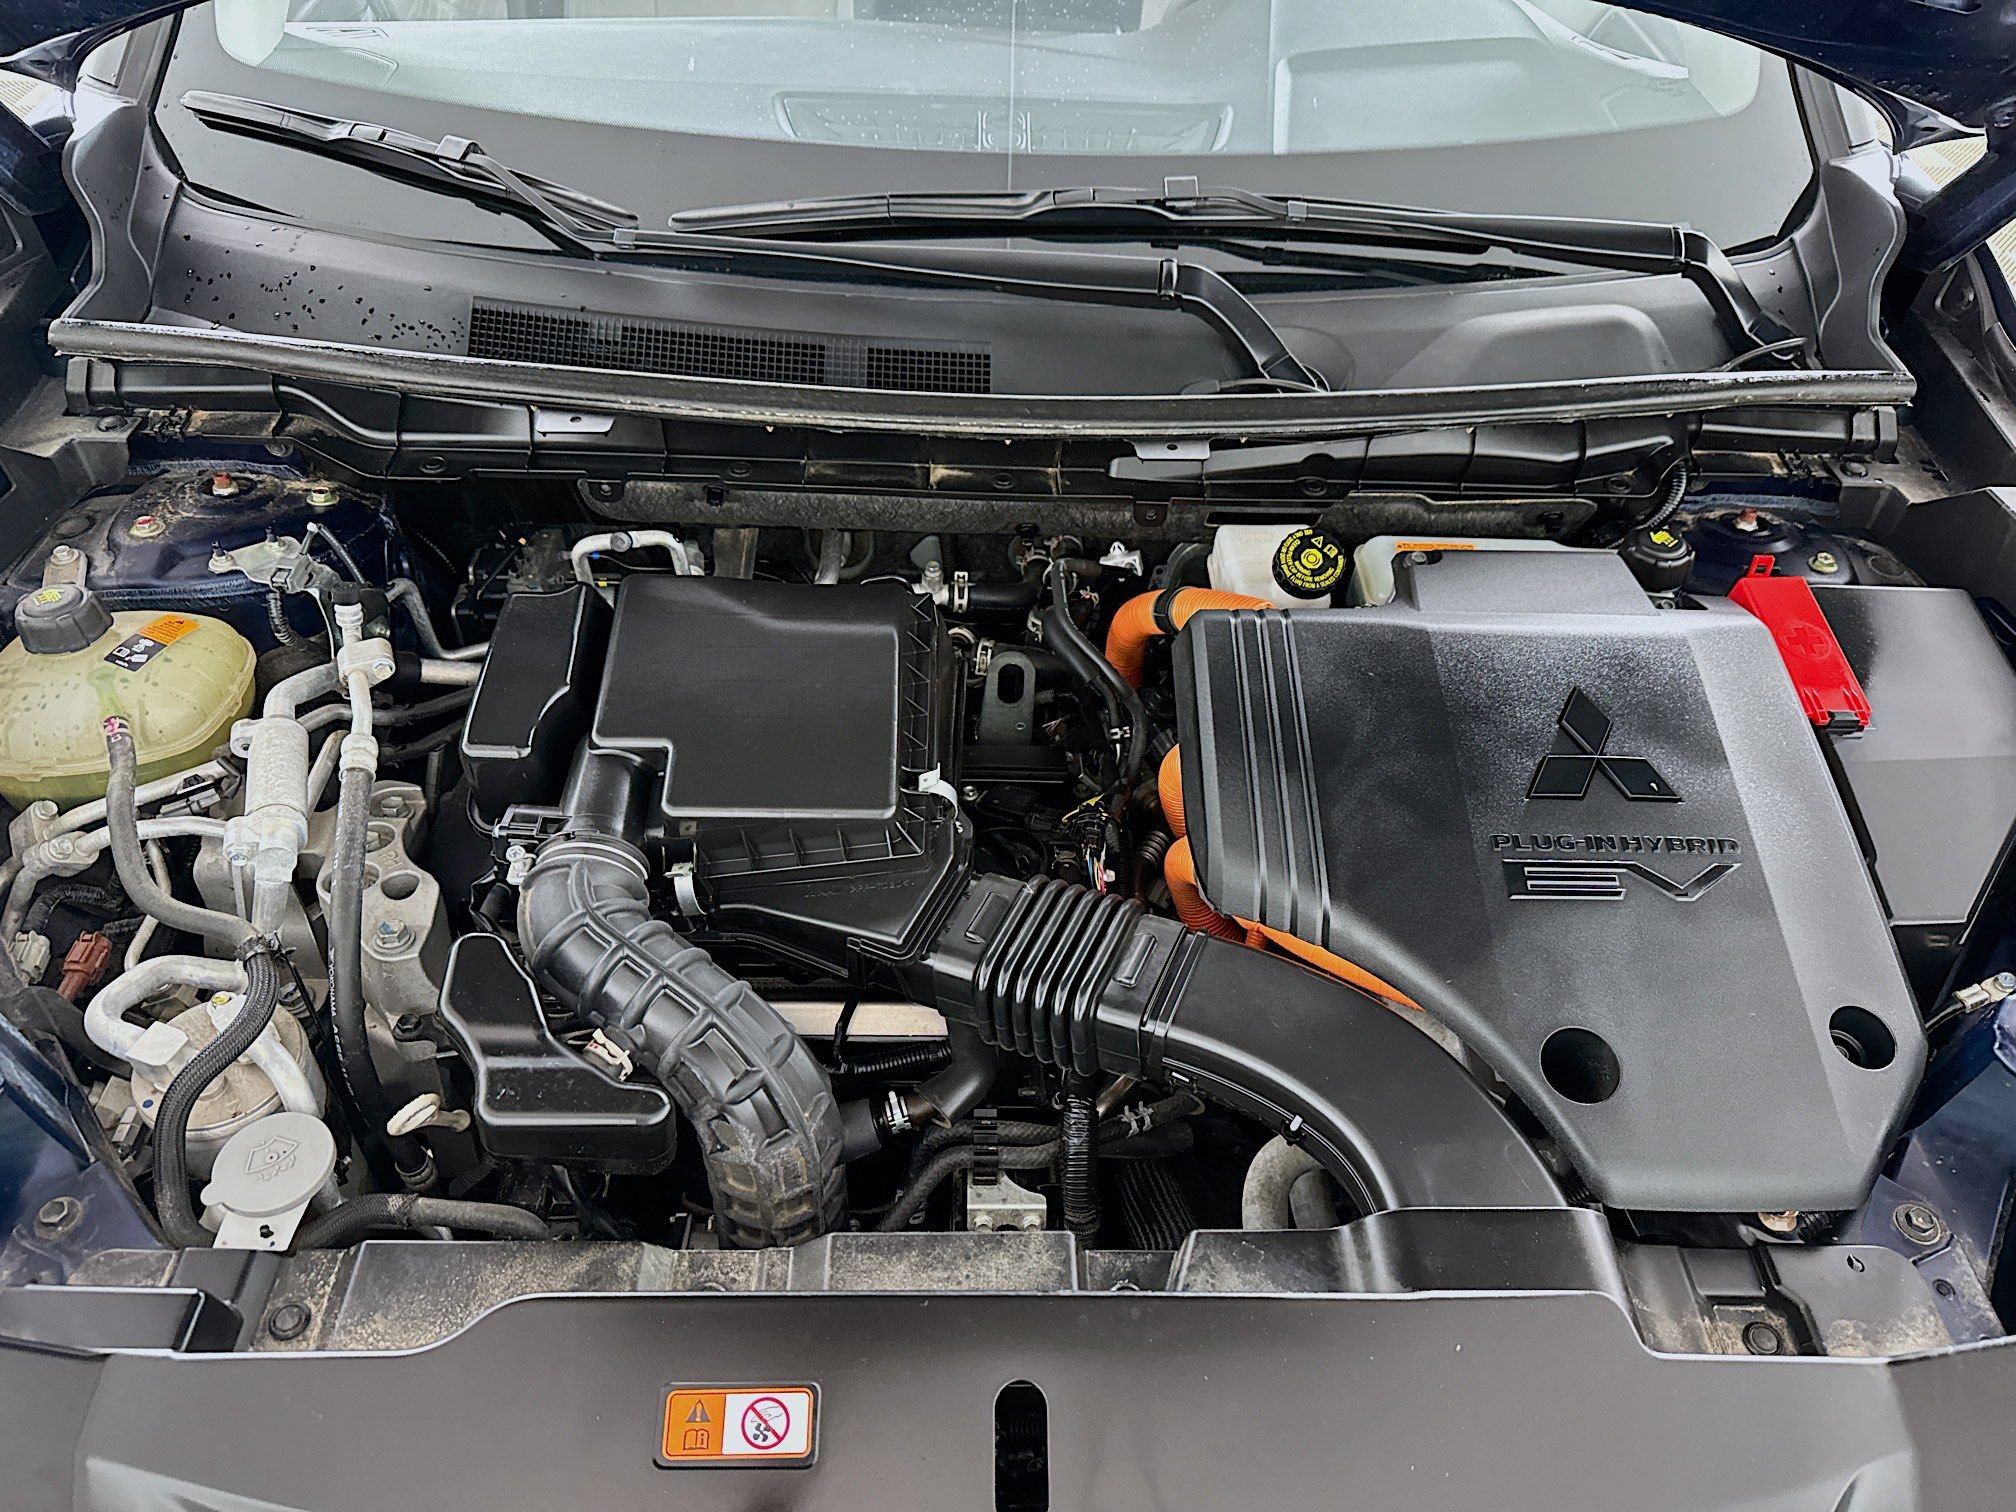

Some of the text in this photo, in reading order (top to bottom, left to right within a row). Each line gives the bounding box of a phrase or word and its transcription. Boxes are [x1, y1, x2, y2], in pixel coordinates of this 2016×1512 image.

[1289, 565, 1298, 573] CAP
[1296, 573, 1313, 582] BEFORE
[1314, 566, 1334, 582] REMOVING
[1290, 575, 1303, 586] FLUID
[1490, 834, 1741, 855] PLUG-IN HYBRID
[1502, 859, 1742, 901] EV
[328, 963, 338, 1017] YOKOHAMA
